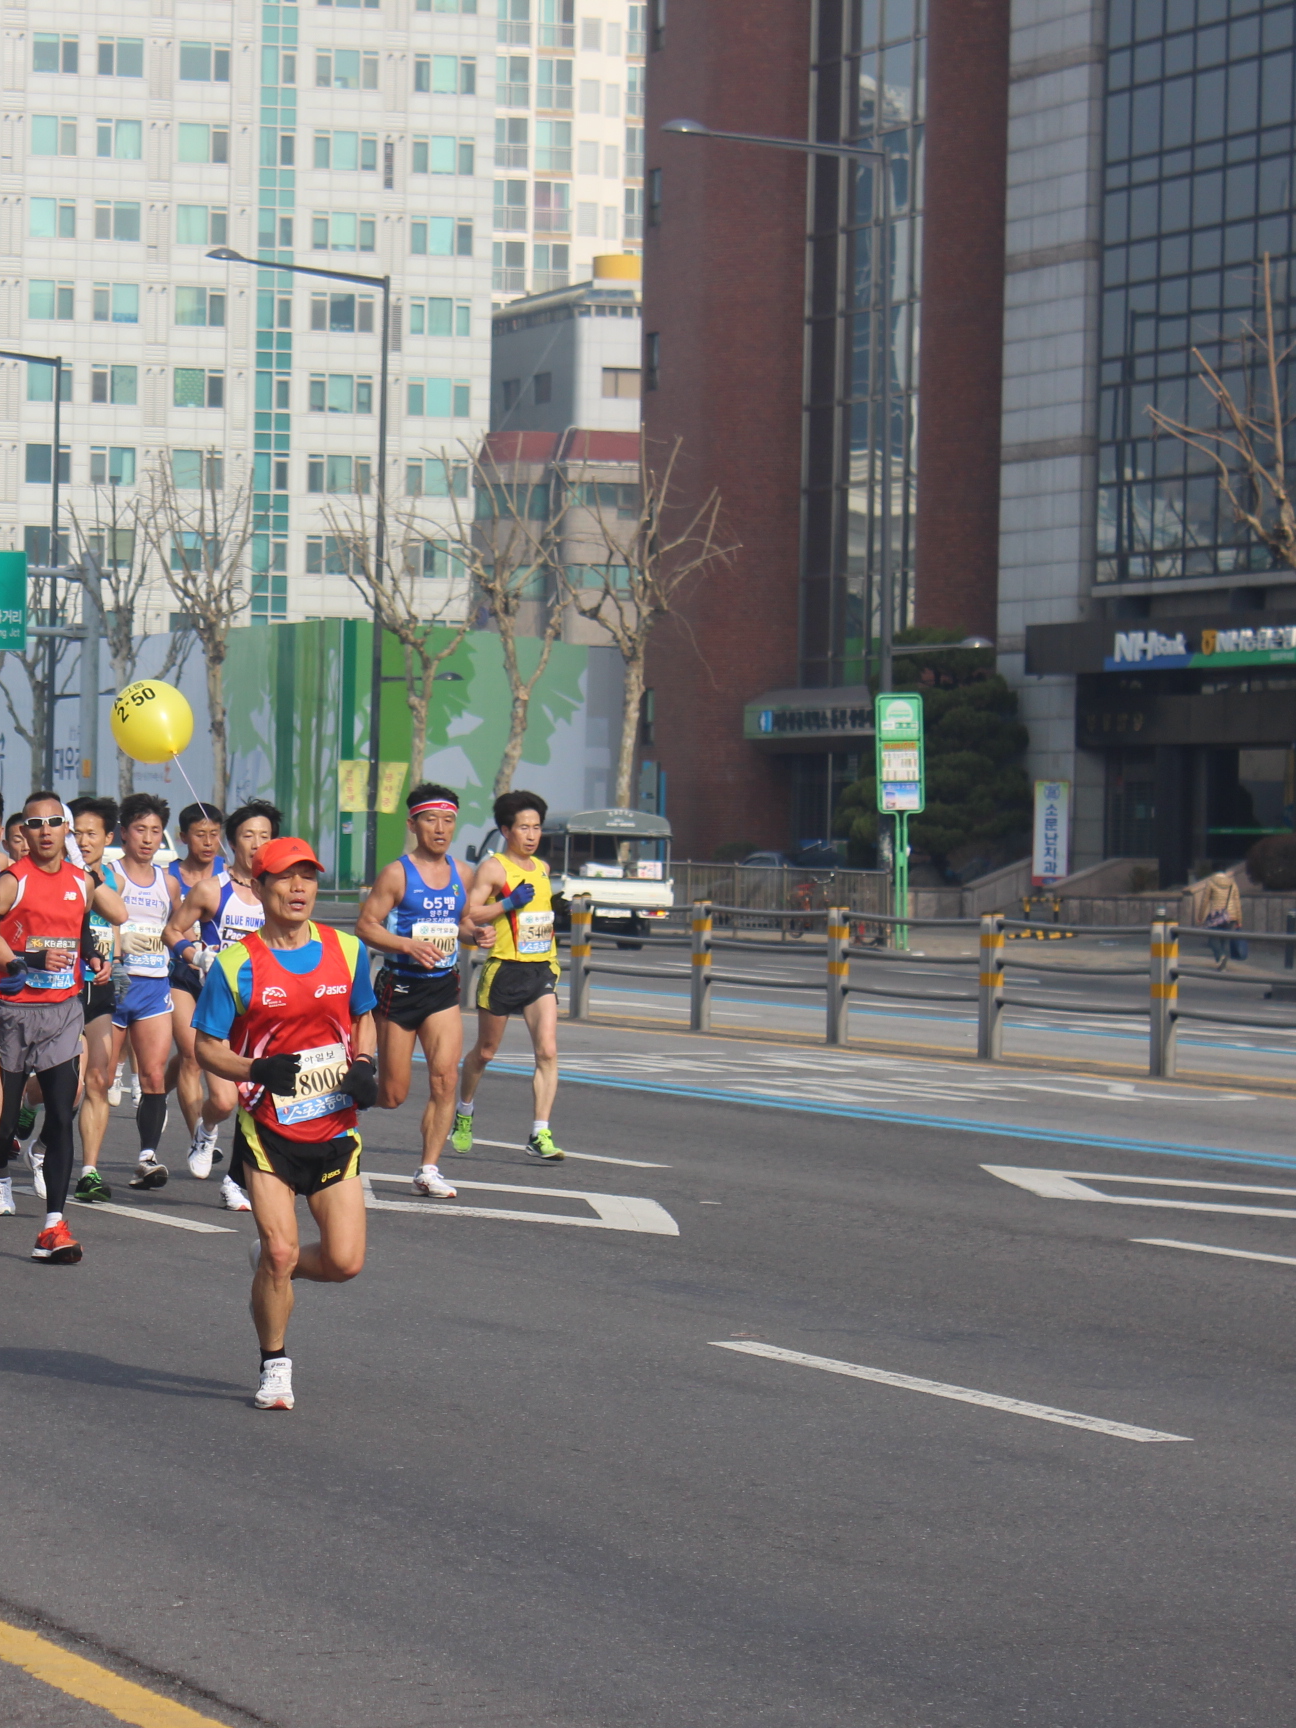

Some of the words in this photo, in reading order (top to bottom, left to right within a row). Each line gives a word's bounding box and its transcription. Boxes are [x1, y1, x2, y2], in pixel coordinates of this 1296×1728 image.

[9, 628, 21, 637] Jct
[1044, 804, 1058, 874] 소문난치과
[226, 915, 244, 926] BLUE
[326, 985, 347, 995] asics
[298, 1051, 335, 1065] 아일보
[286, 1094, 347, 1123] 스포츠동아
